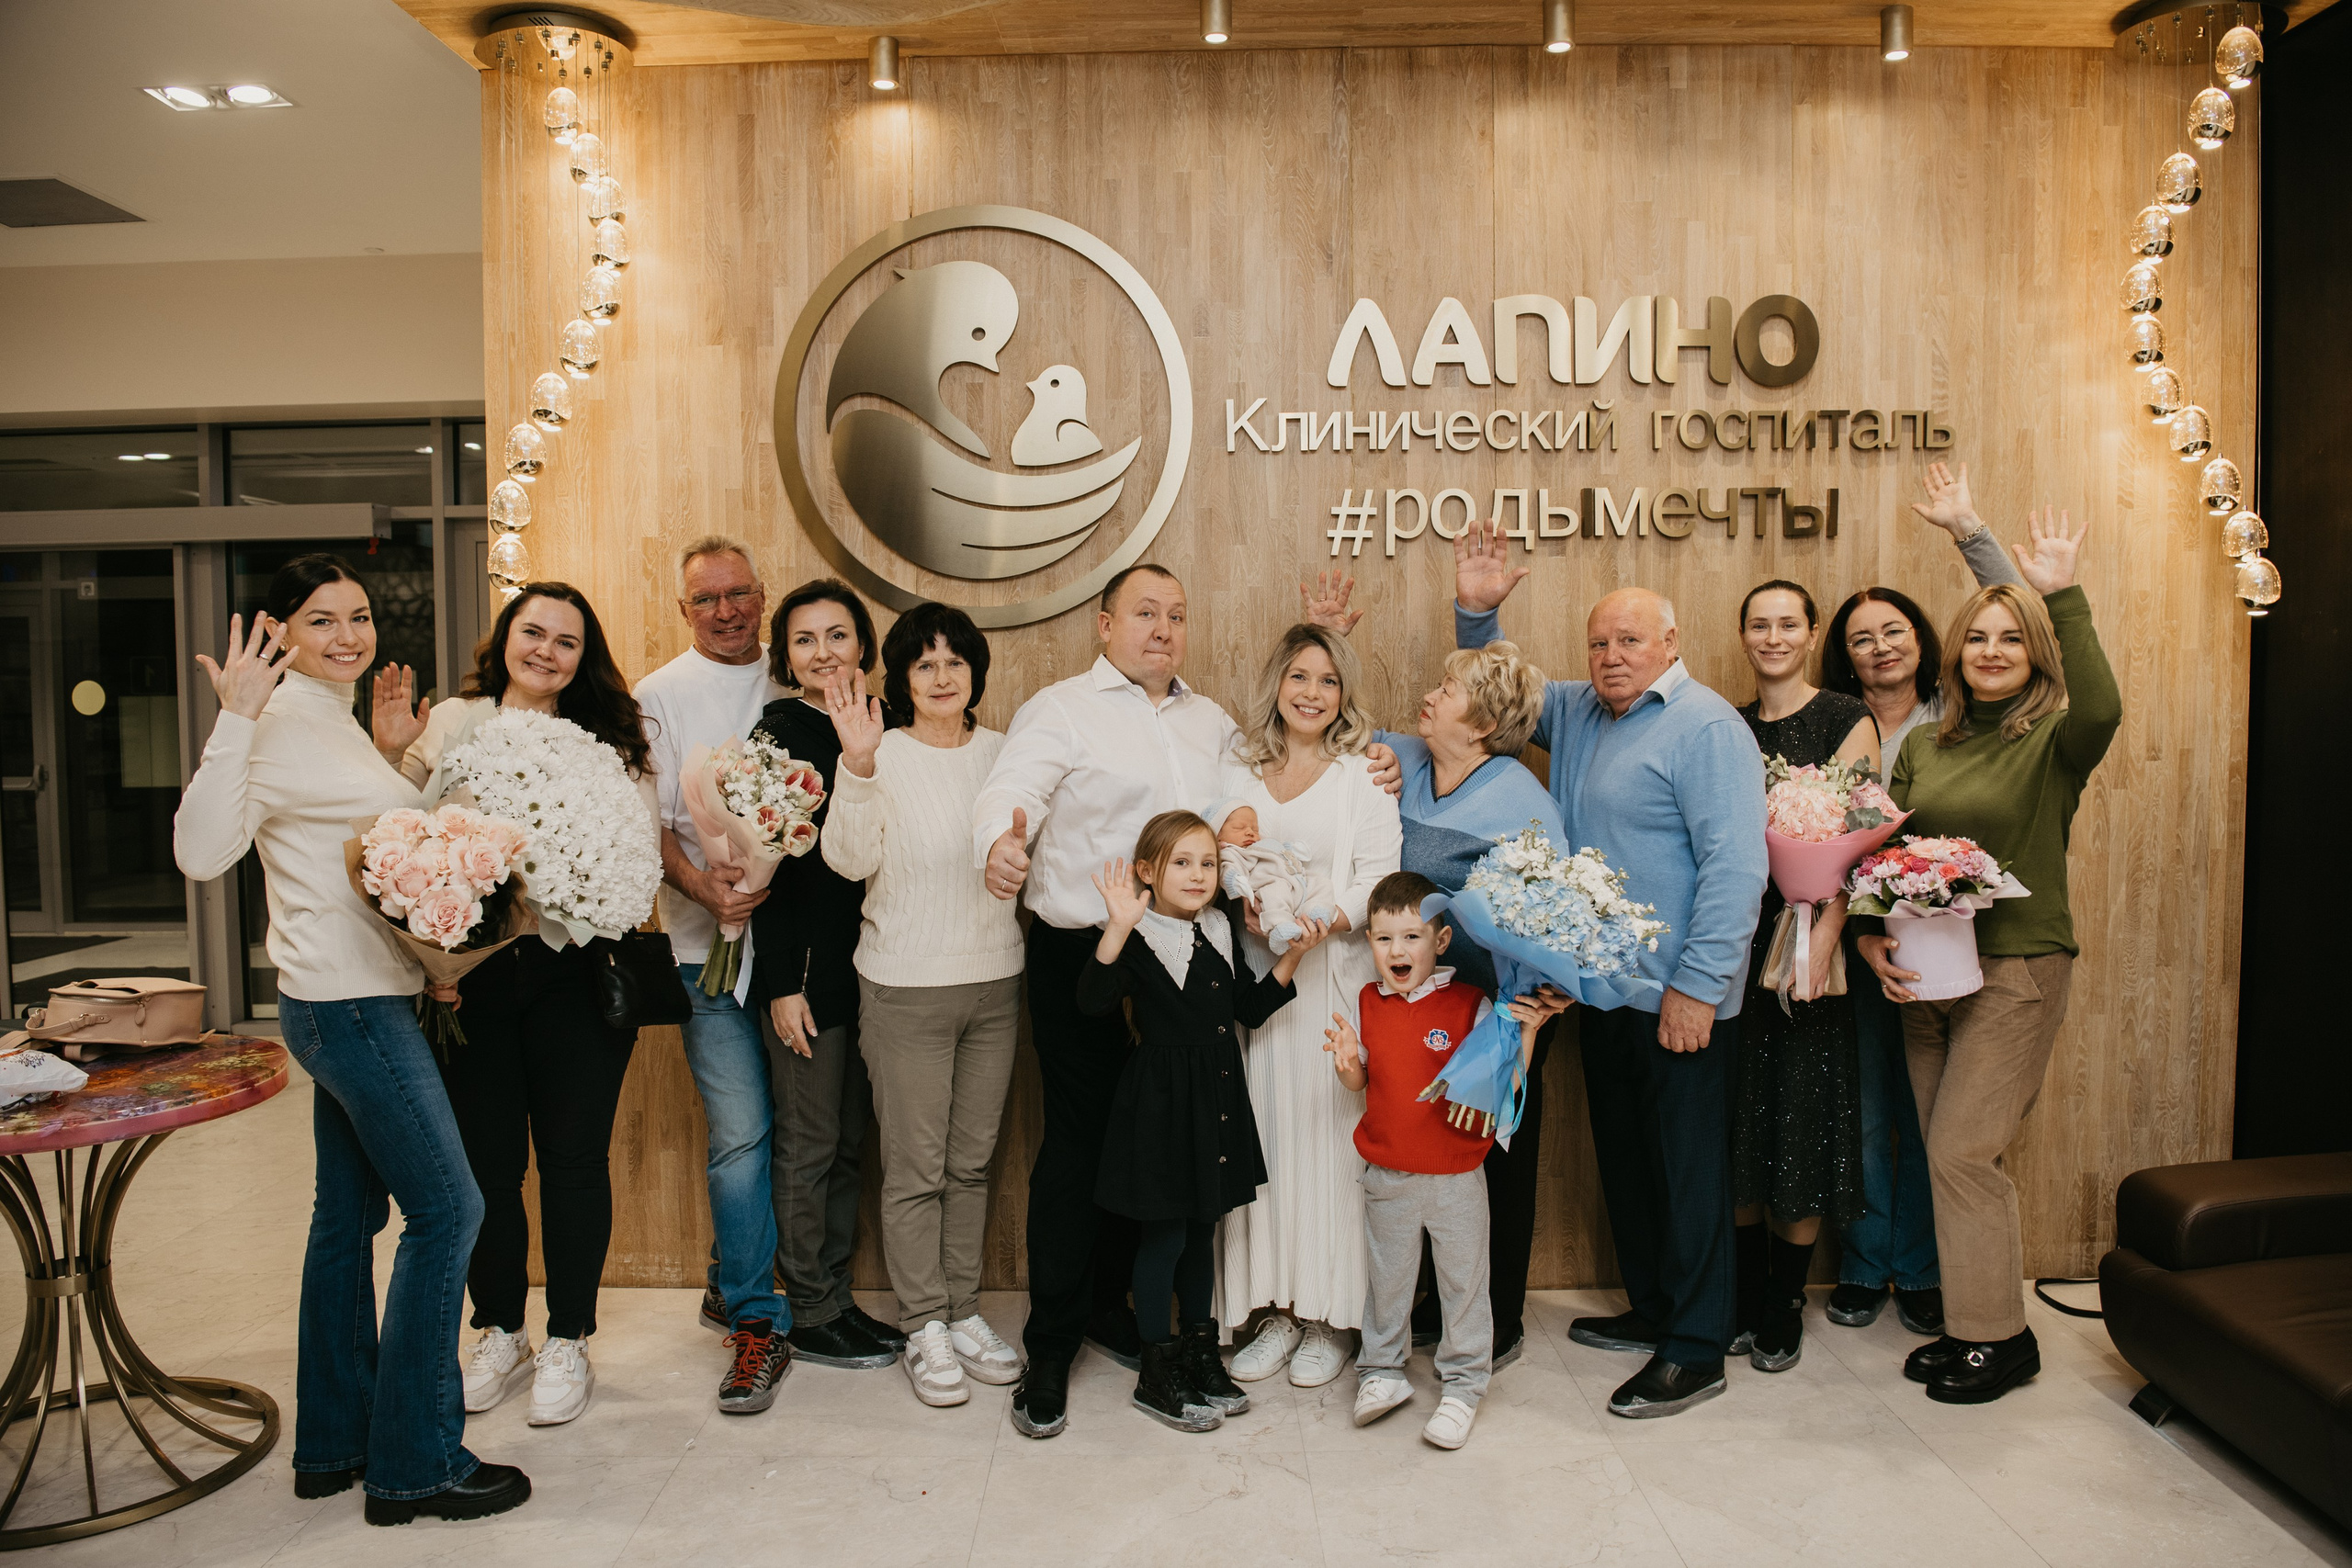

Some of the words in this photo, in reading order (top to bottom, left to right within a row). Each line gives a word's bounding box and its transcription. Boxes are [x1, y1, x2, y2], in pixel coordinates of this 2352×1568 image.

[1327, 293, 1820, 388] ЛАПИНО
[1226, 397, 1620, 453] Клинический
[1652, 409, 1957, 450] госпиталь
[1327, 487, 1839, 558] #родымечты
